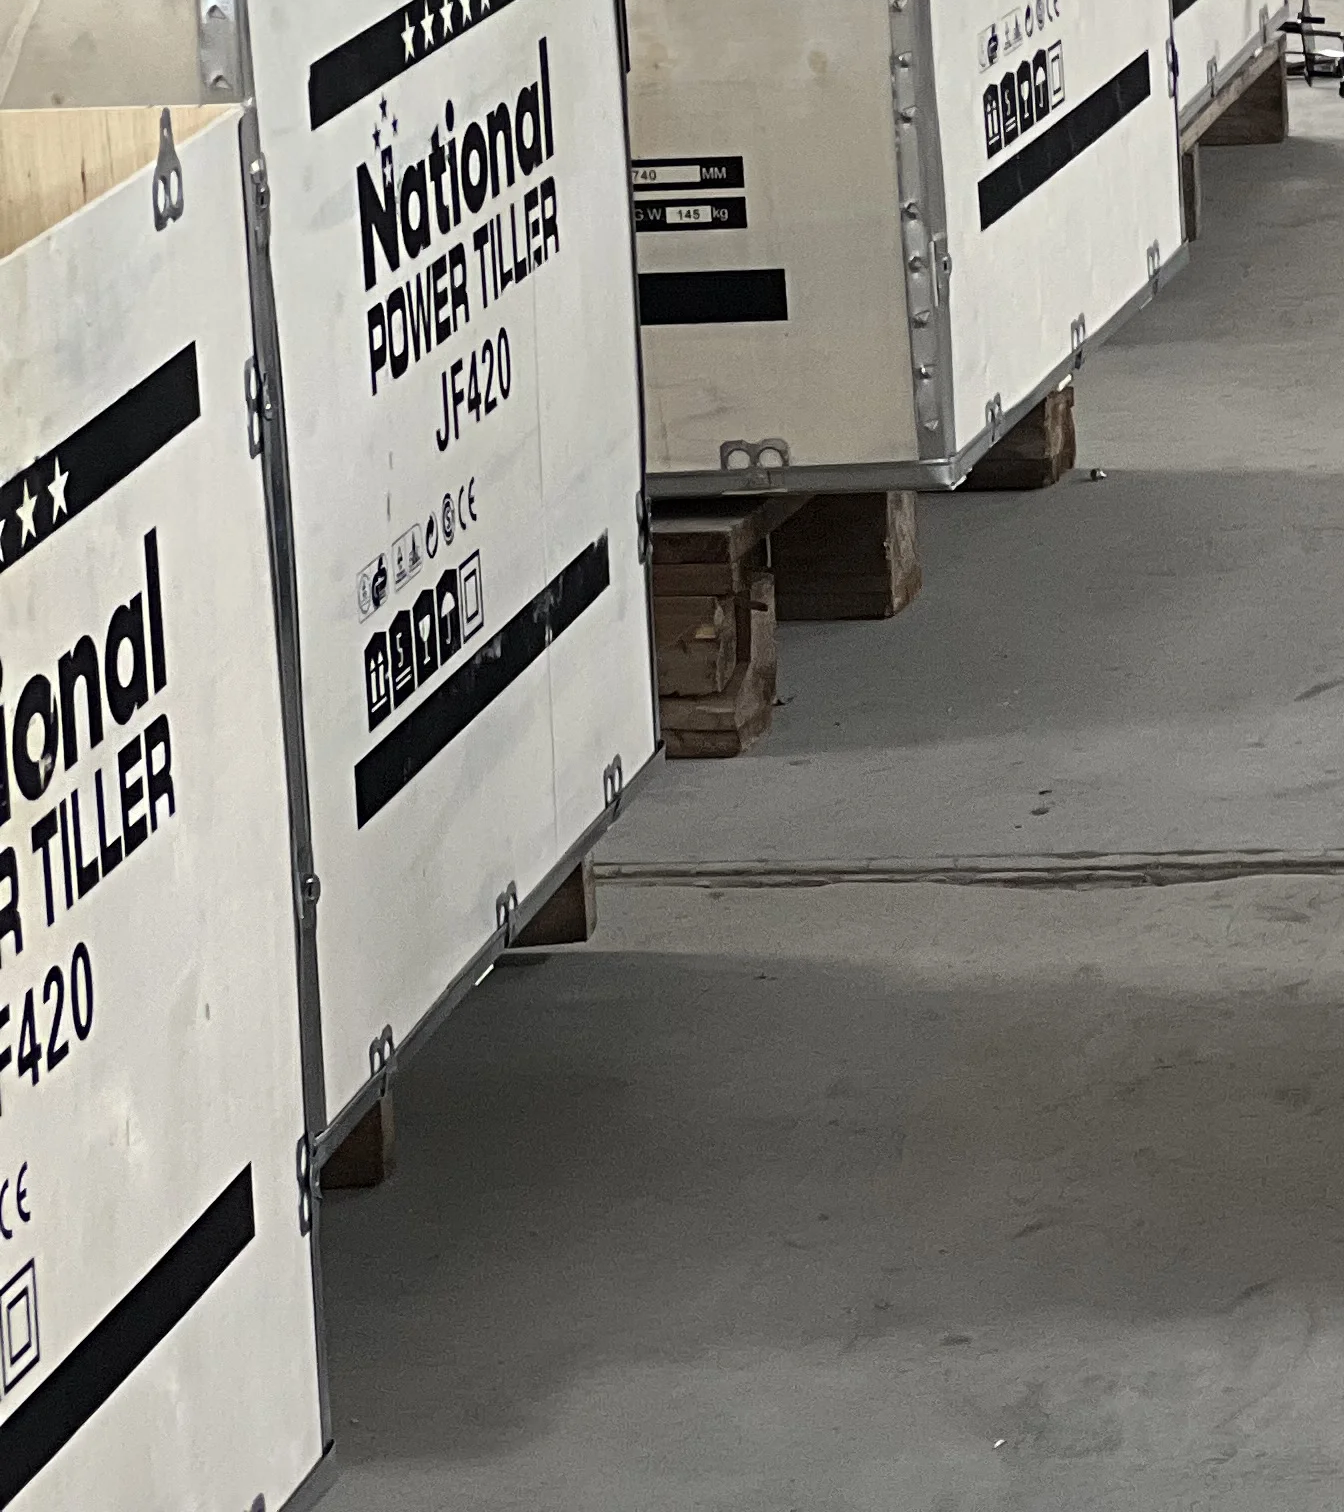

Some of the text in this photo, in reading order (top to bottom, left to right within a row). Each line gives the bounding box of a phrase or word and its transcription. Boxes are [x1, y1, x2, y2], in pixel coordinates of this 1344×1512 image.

[355, 37, 554, 291] National
[633, 167, 727, 181] 740 MM
[678, 209, 700, 220] 145
[713, 208, 729, 221] kg
[366, 175, 561, 396] POWER TILLER
[436, 349, 512, 452] JF420
[33, 713, 177, 934] TILLER
